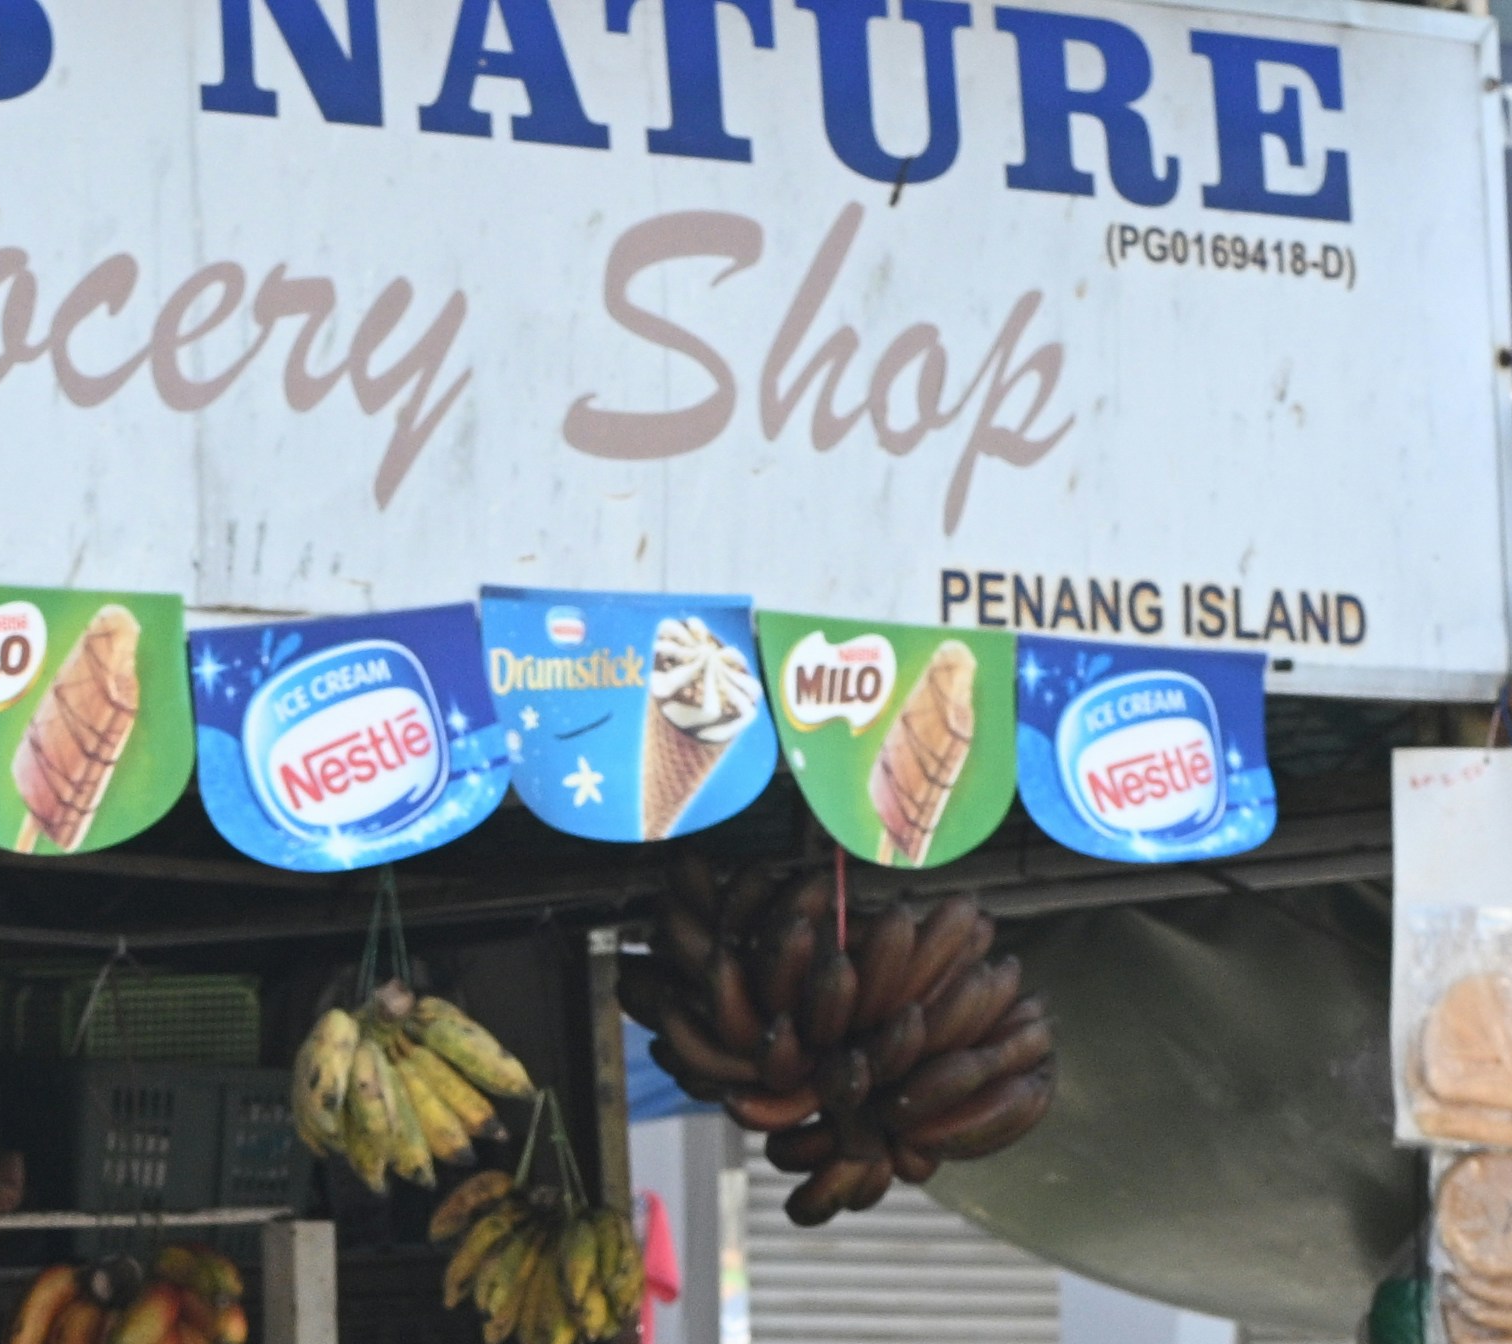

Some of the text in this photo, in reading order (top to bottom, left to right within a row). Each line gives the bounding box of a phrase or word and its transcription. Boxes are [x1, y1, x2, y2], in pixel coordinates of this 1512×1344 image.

[198, 0, 1352, 222] NATURE
[1105, 220, 1357, 289] (PG0169418-D)
[562, 201, 1075, 536] Shop
[939, 568, 1367, 648] PENANG ISLAND
[273, 656, 394, 724] ICE CREAM
[487, 644, 646, 694] Drumstick
[794, 662, 880, 709] MILO
[1085, 688, 1187, 729] ICE CREAM
